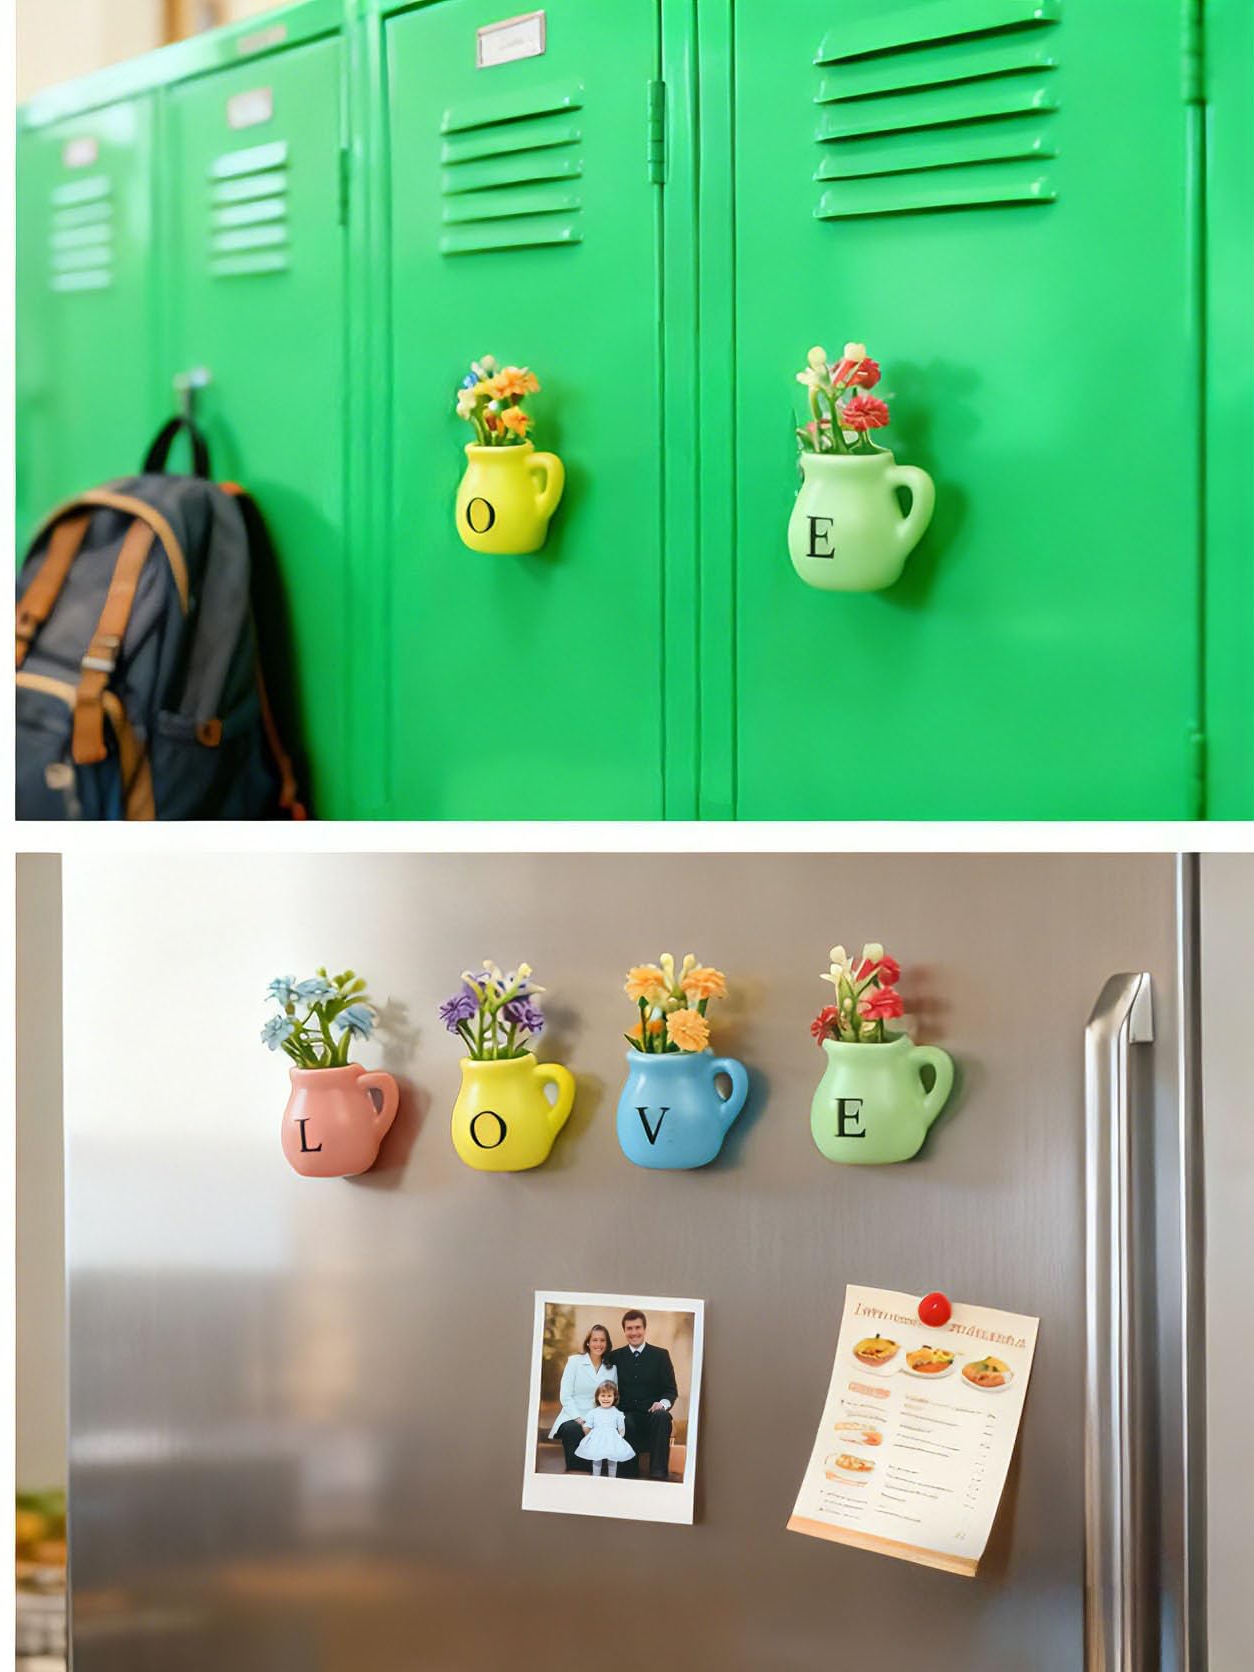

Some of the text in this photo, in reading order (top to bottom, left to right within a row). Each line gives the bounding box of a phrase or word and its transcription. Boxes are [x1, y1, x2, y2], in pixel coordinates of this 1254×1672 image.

[466, 496, 496, 534] O
[806, 515, 836, 559] E
[295, 1098, 867, 1153] L O V E
